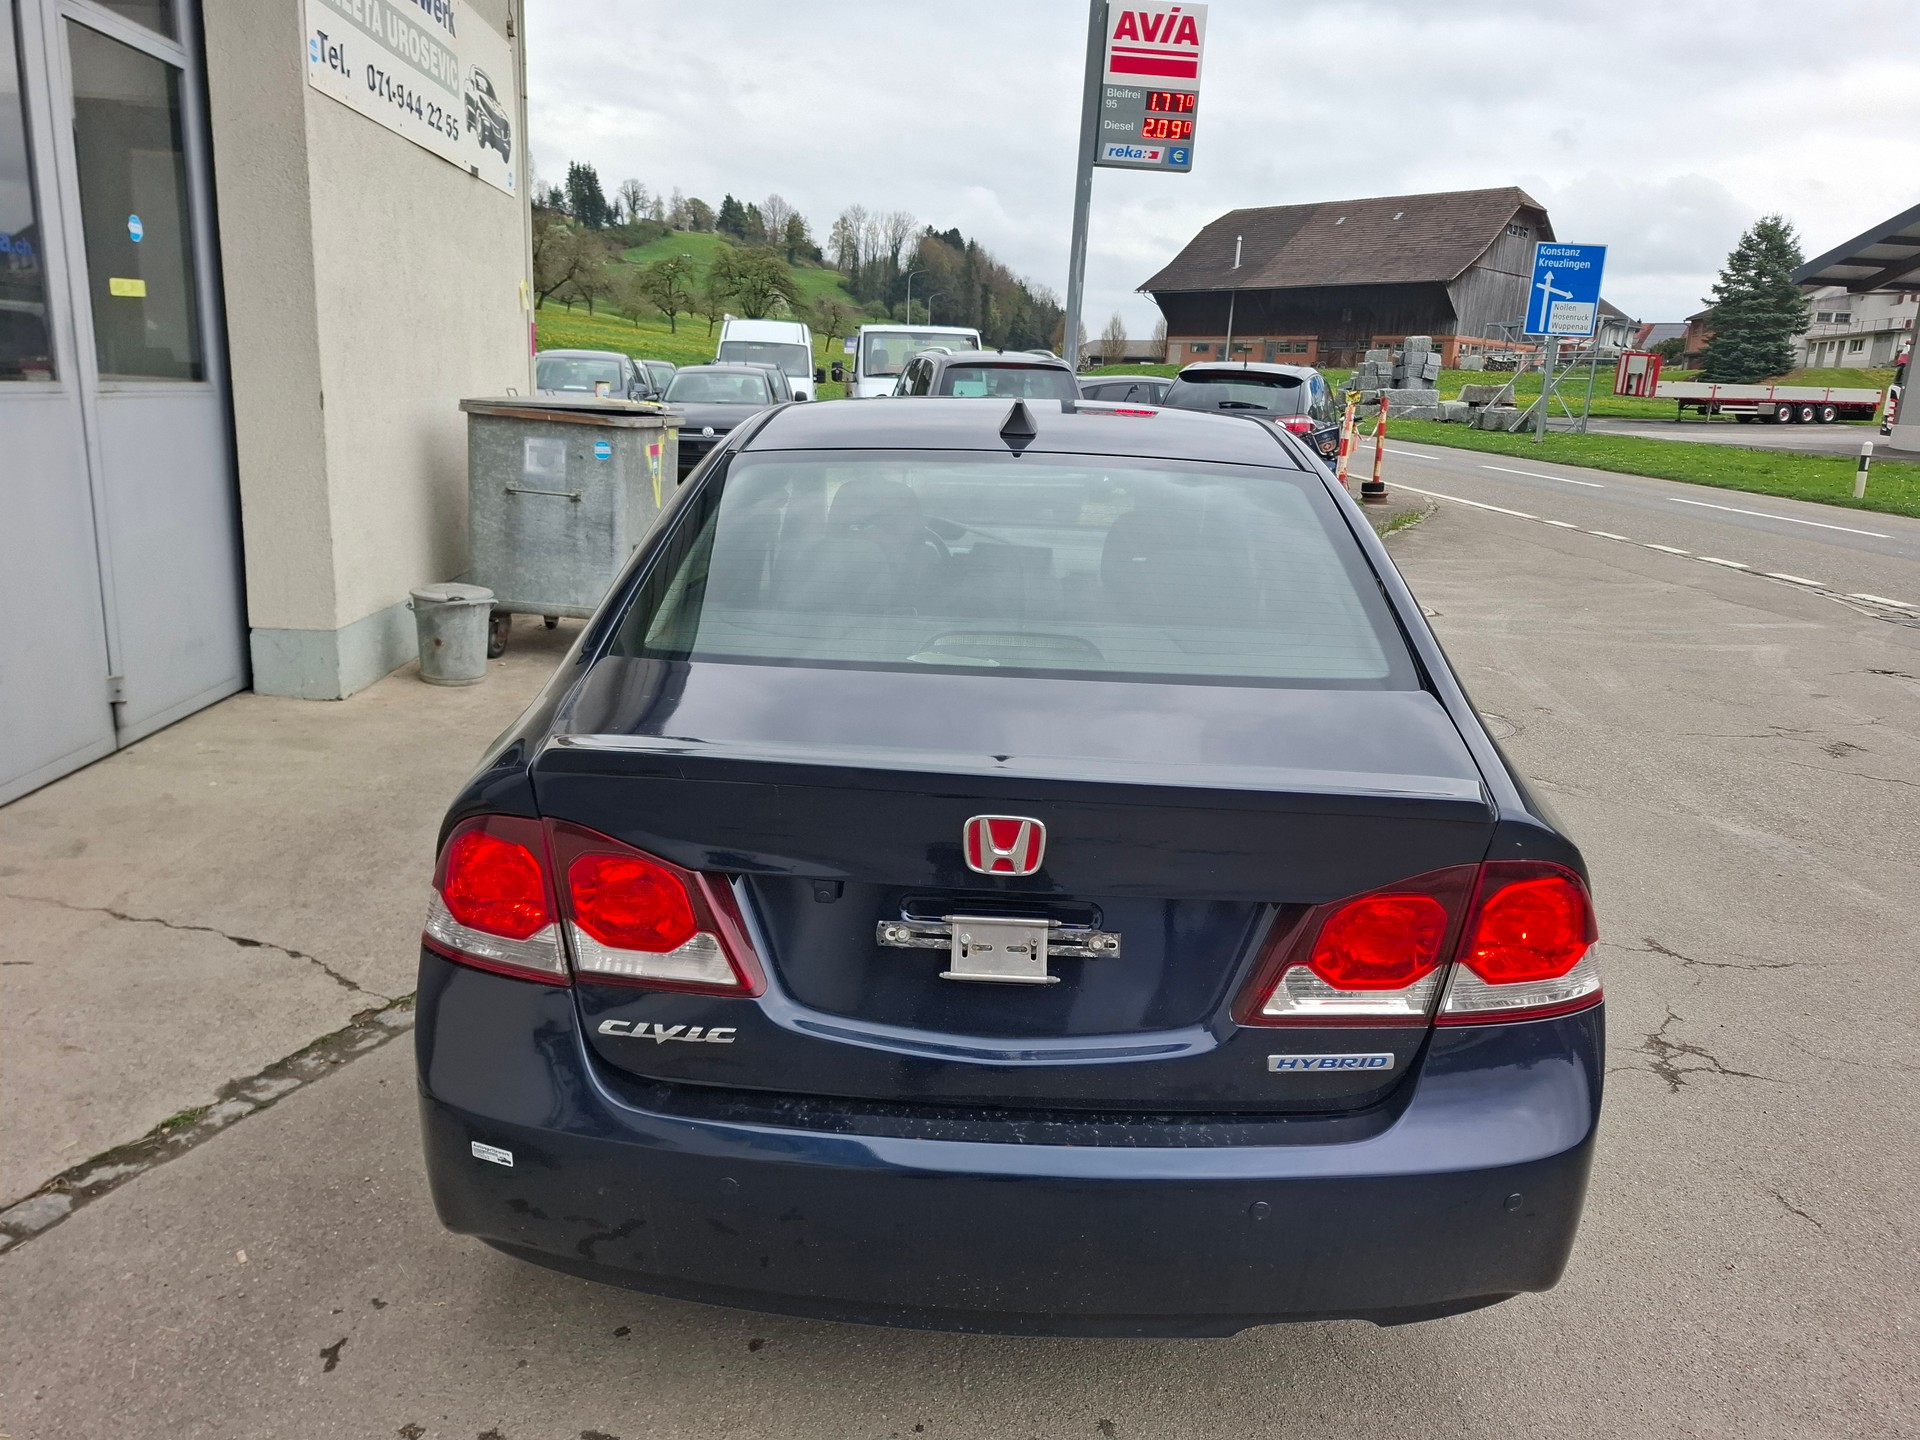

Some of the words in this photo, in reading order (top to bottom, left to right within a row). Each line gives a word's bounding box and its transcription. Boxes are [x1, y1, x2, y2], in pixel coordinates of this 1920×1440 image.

[1113, 7, 1199, 46] AVIA
[386, 10, 459, 91] UROSEVIC
[317, 30, 350, 78] Tel.
[427, 102, 443, 132] 22
[445, 115, 459, 141] 55
[1107, 88, 1140, 99] Bleifrei
[1106, 100, 1117, 109] 95
[1104, 120, 1134, 131] Diesel
[1541, 246, 1580, 256] Konstanz
[1539, 258, 1591, 271] Kreuzlingen
[1554, 303, 1577, 311] Nollen
[1552, 313, 1589, 321] Hosenruck
[1551, 322, 1588, 331] Wuppenau
[598, 1019, 737, 1044] CIVIC
[1276, 1057, 1388, 1069] HYBRID
